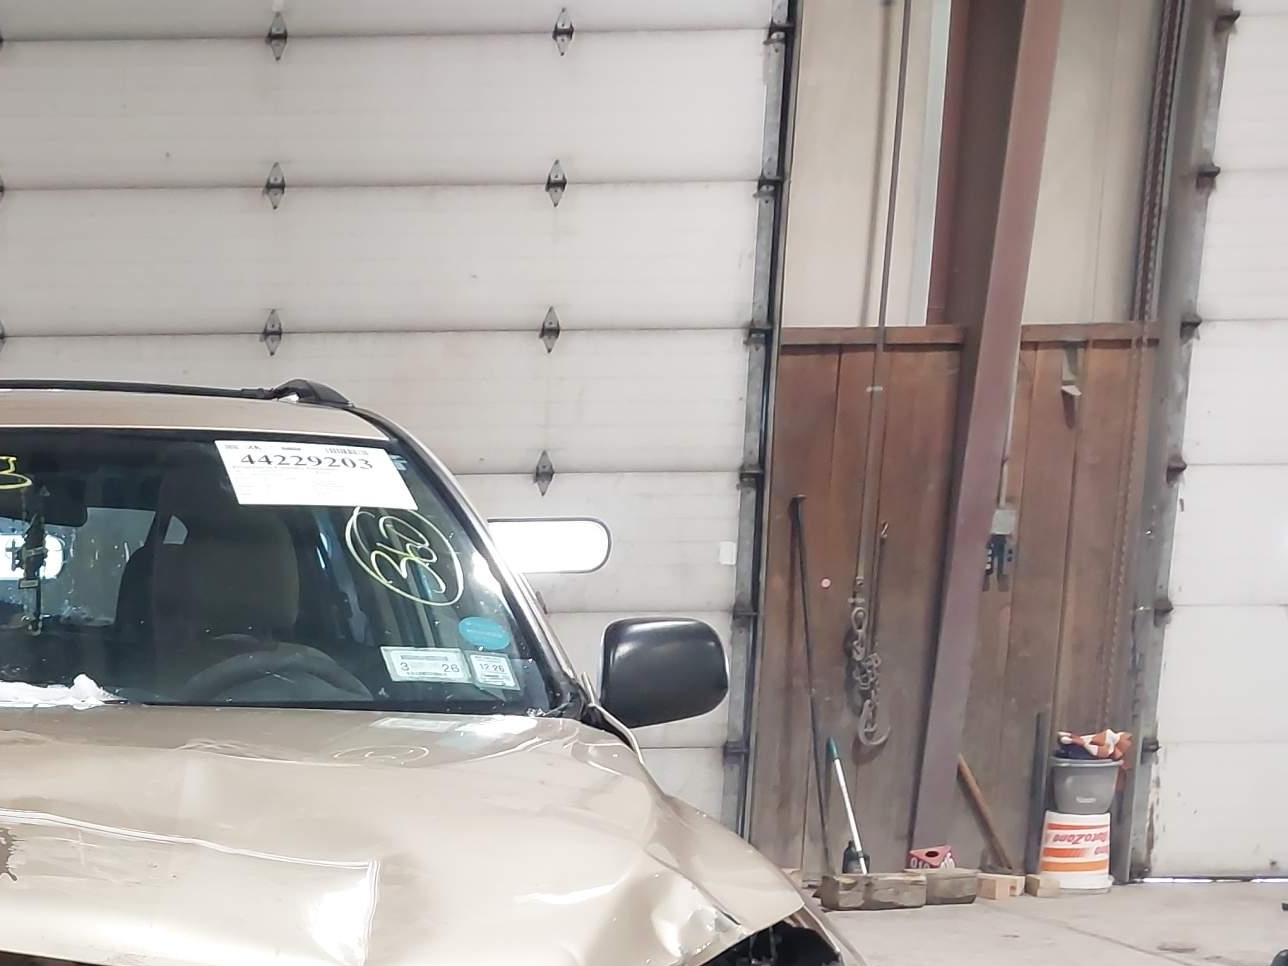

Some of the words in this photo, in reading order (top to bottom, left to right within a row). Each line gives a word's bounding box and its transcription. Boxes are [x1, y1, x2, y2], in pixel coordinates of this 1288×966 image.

[240, 453, 374, 470] 44229203
[400, 662, 410, 672] 3
[441, 663, 460, 673] 26
